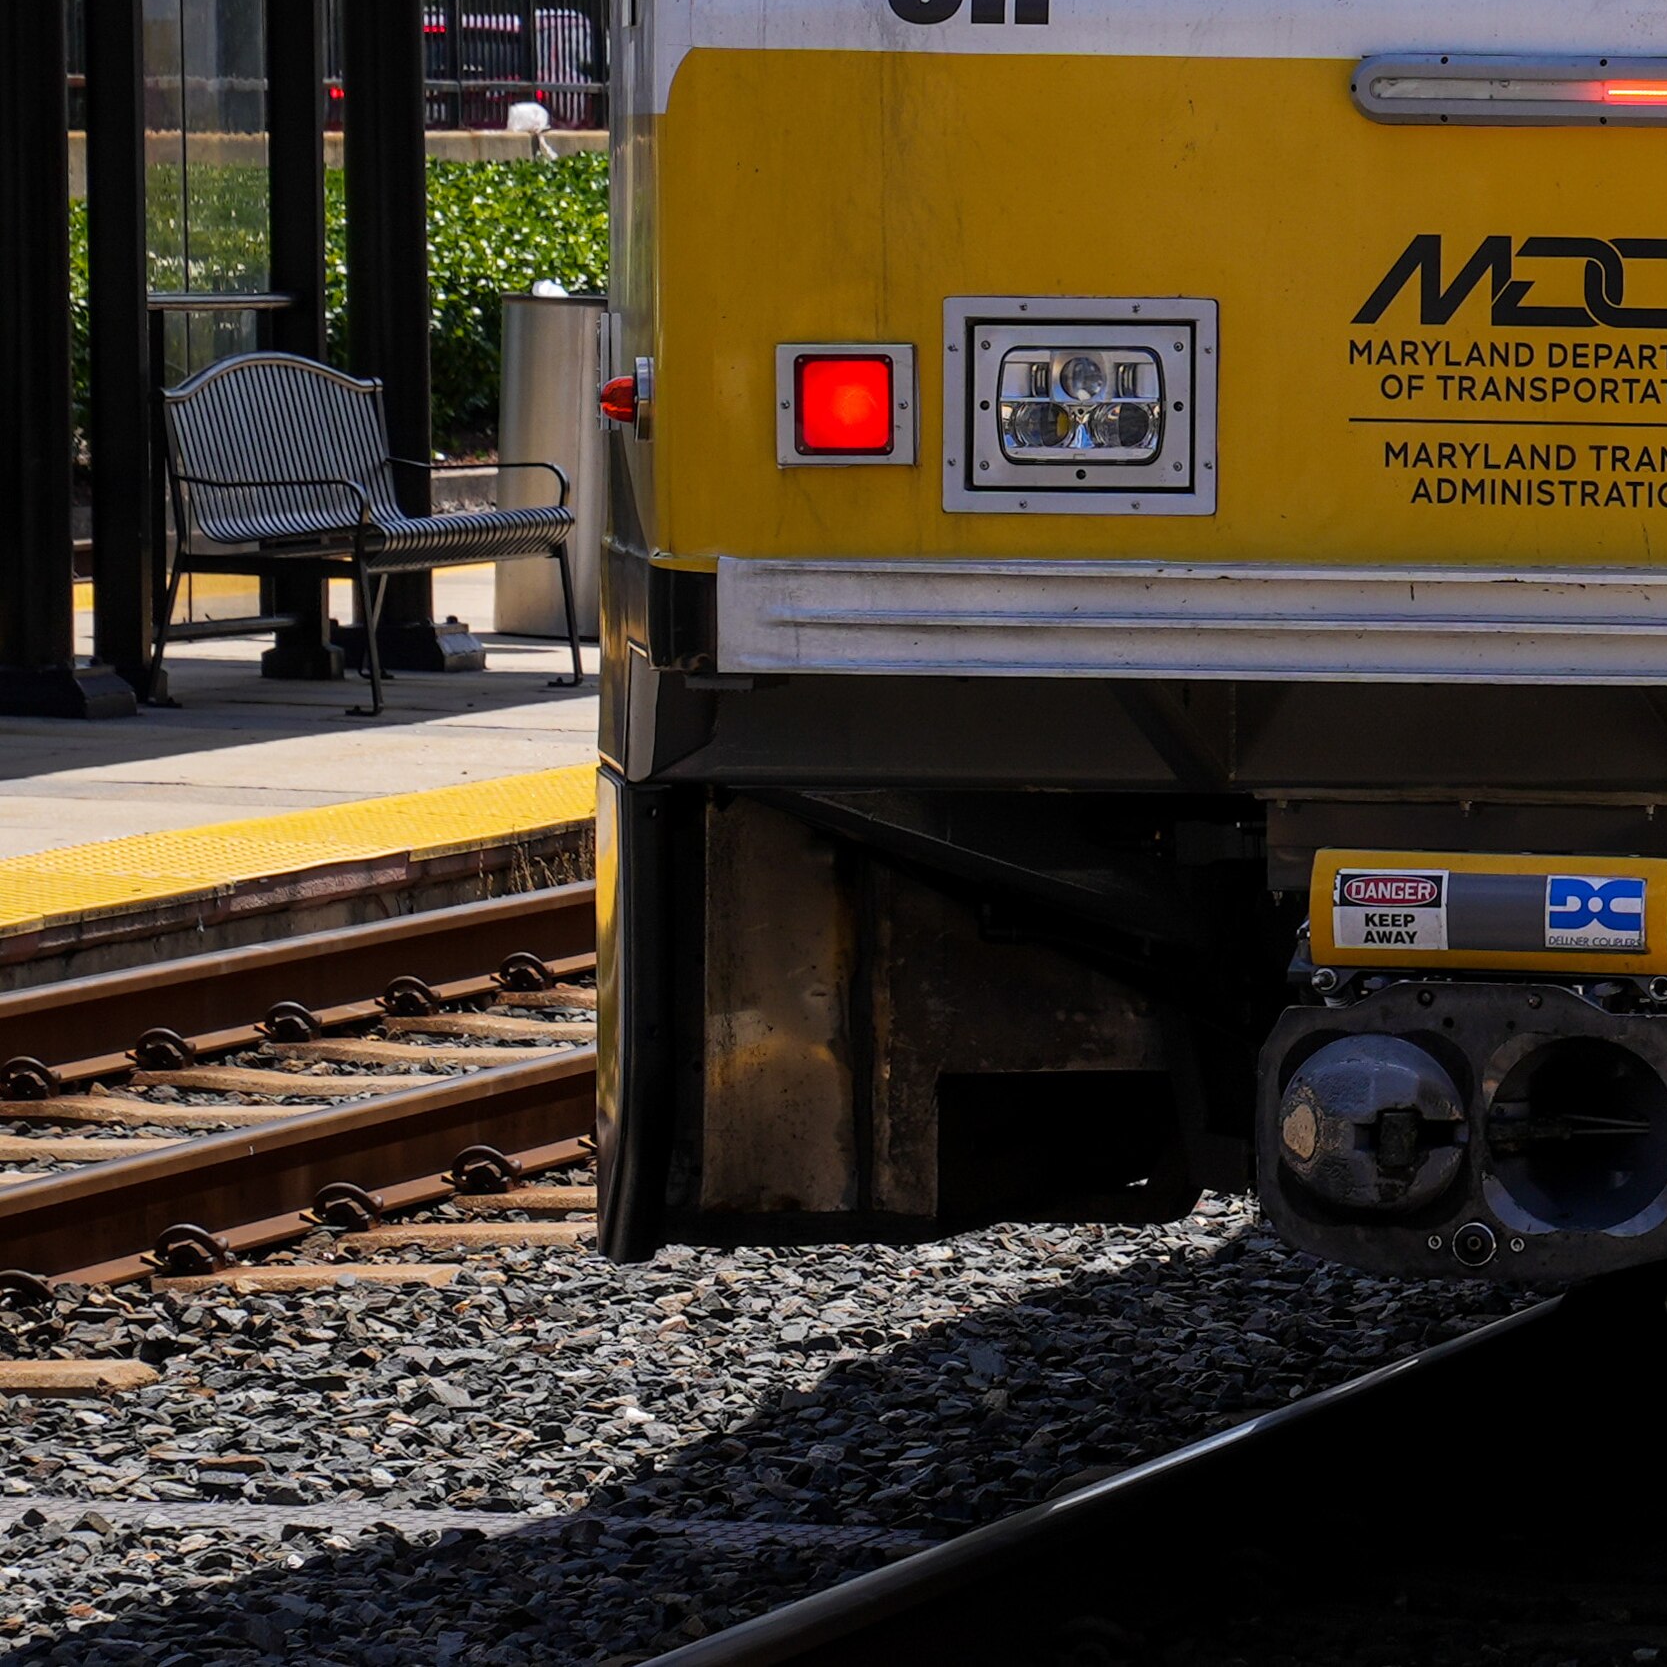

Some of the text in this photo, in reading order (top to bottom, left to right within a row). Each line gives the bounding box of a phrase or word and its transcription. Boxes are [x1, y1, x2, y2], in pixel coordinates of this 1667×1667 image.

[1348, 340, 1535, 369] MARYLAND
[1380, 374, 1426, 401] OF
[1384, 441, 1577, 471] MARYLAND
[1350, 878, 1432, 902] DANGER
[1364, 913, 1416, 928] KEEP
[1363, 930, 1419, 946] AWAY
[1548, 935, 1591, 947] DELLNER
